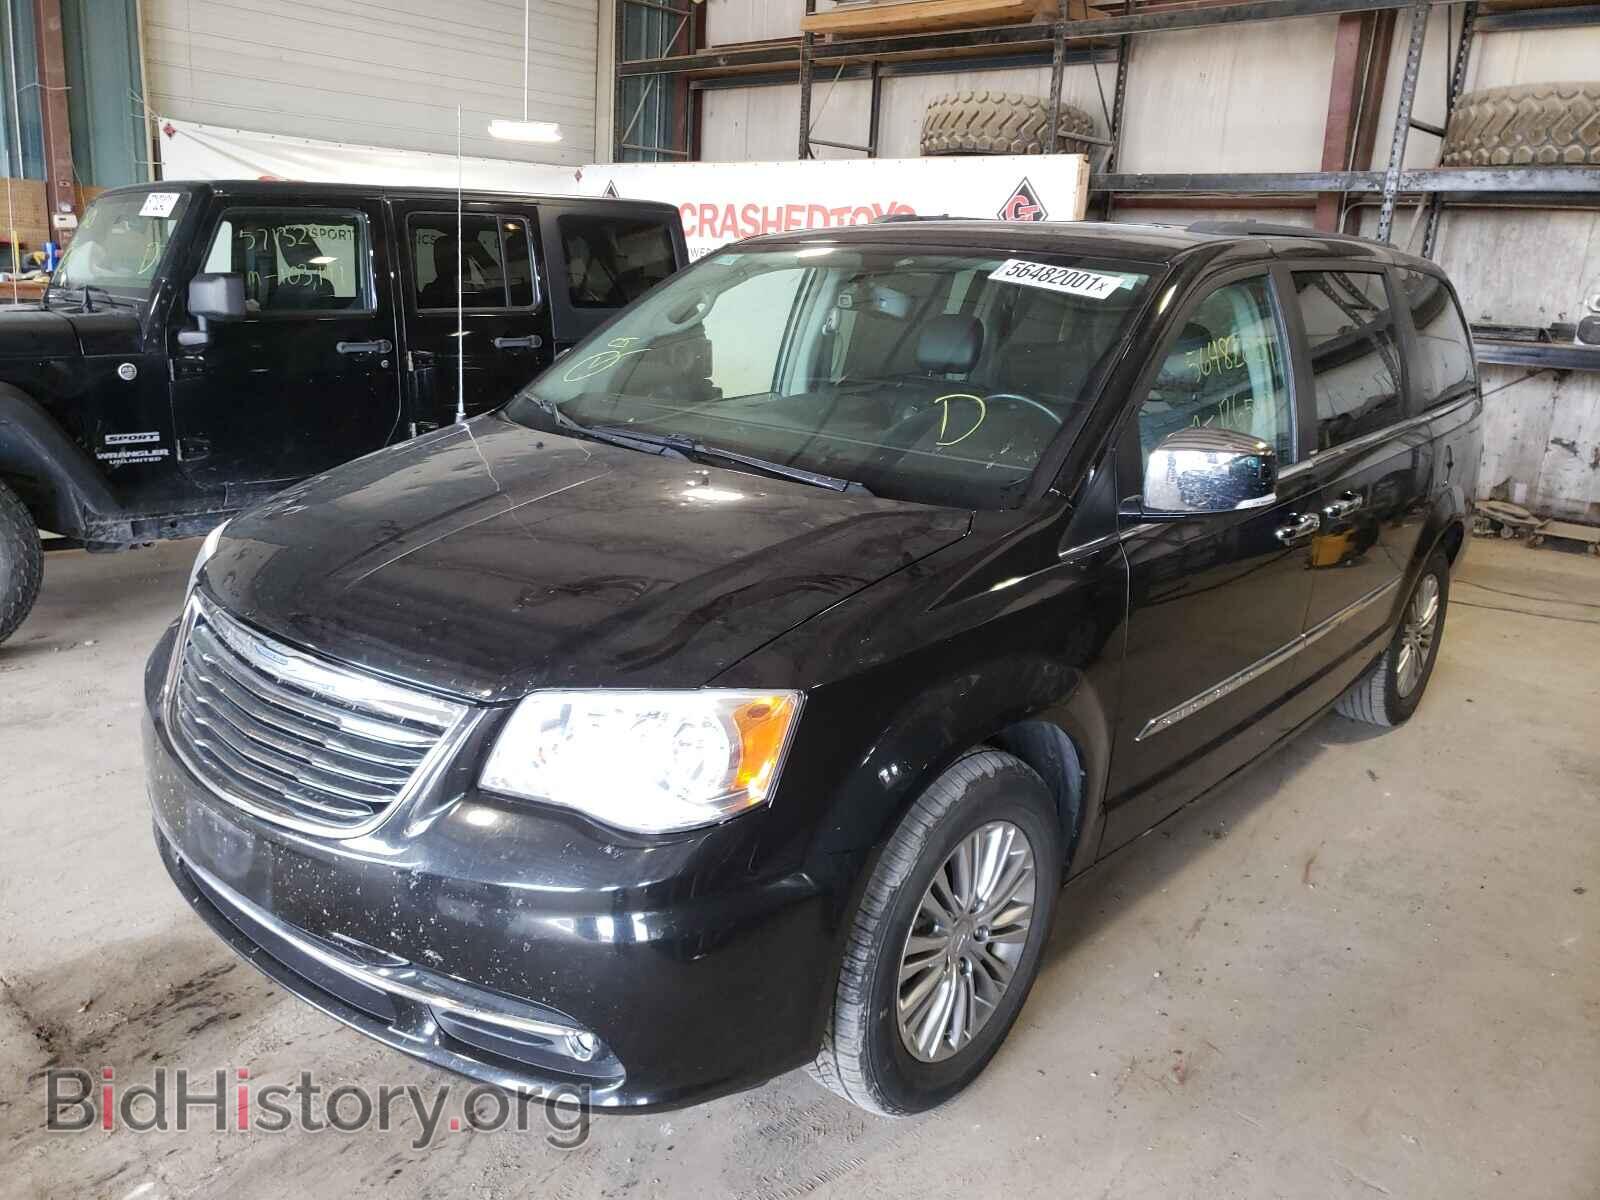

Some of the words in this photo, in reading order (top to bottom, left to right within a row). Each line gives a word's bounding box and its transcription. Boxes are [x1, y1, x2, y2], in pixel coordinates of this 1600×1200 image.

[933, 393, 987, 446] D
[108, 433, 155, 443] SPORT
[96, 448, 170, 460] WRANGLER
